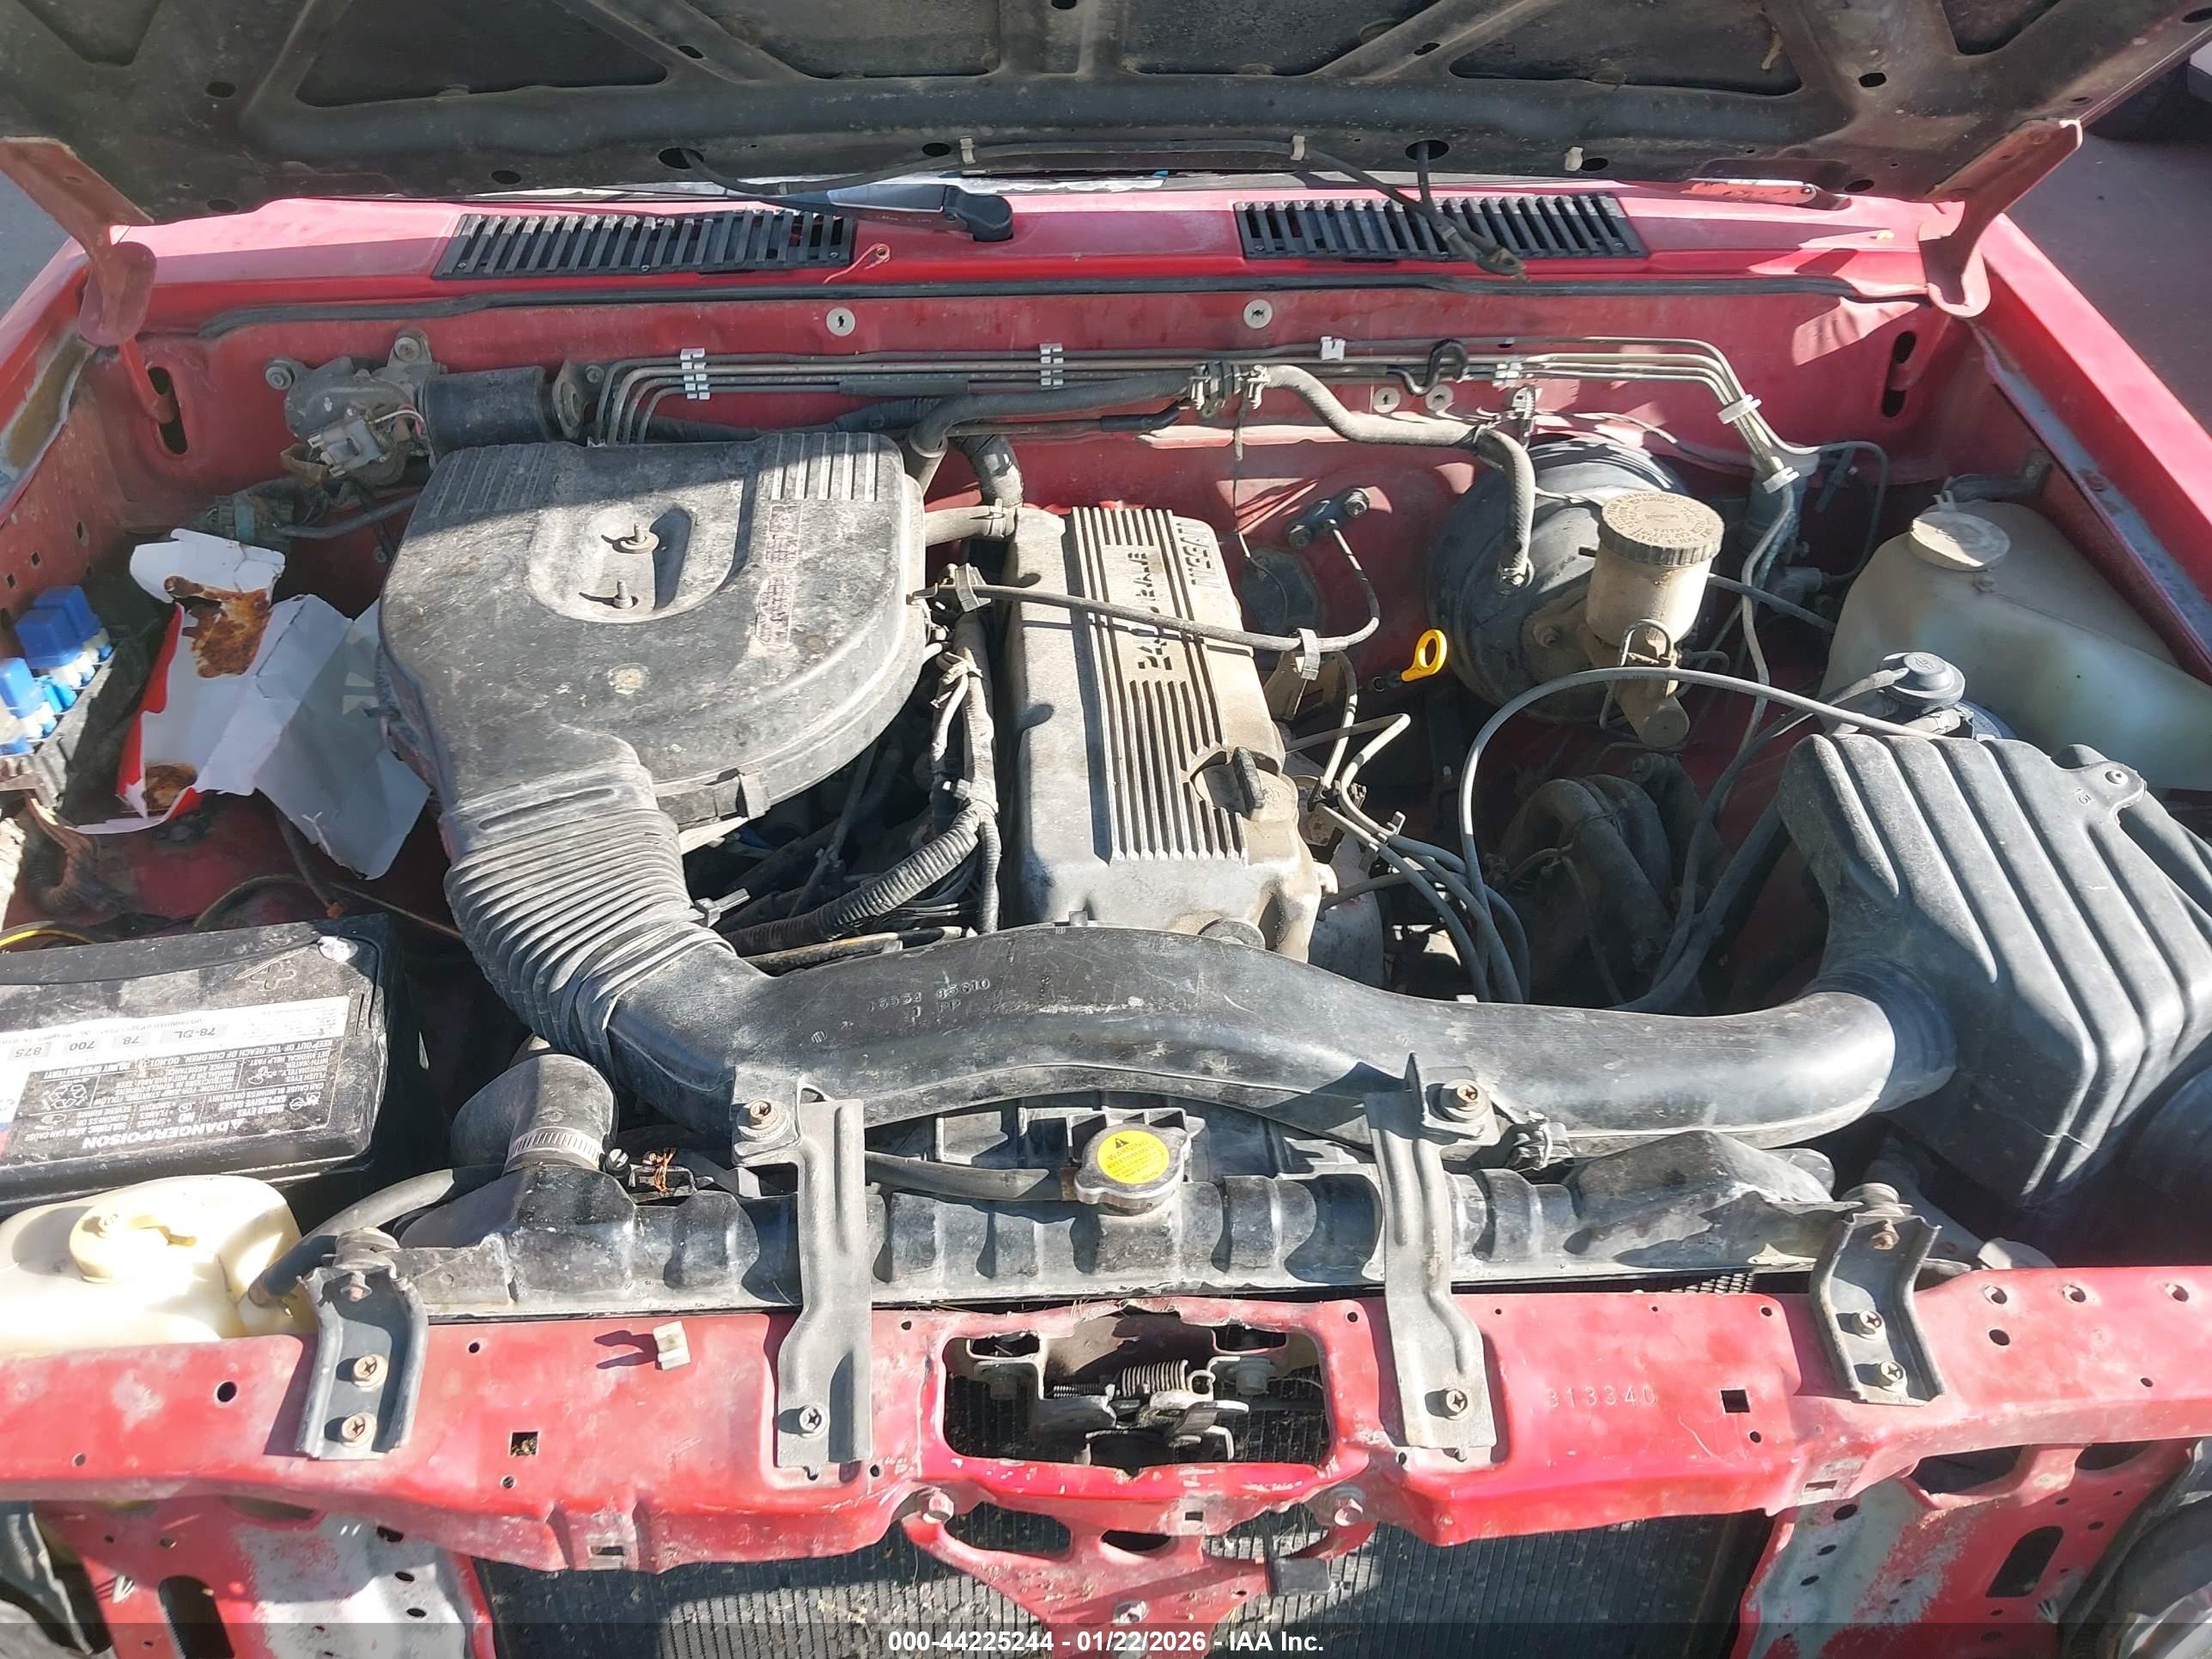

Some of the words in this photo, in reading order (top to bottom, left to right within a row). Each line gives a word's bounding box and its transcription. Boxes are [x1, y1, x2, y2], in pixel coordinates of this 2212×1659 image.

[173, 1024, 216, 1039] 78-DL
[69, 1039, 96, 1052] 700
[123, 1036, 141, 1046] 78
[296, 1042, 312, 1050] OUT
[239, 1047, 264, 1056] REACH
[265, 1045, 281, 1054] THE
[282, 1043, 296, 1052] OF
[15, 1047, 43, 1059] 875
[285, 1084, 308, 1092] CAUSE
[93, 1095, 123, 1105] FOLLOW
[177, 1111, 195, 1122] NO
[81, 1120, 229, 1148] DANGER/POISON
[1547, 1385, 1657, 1409] 313340
